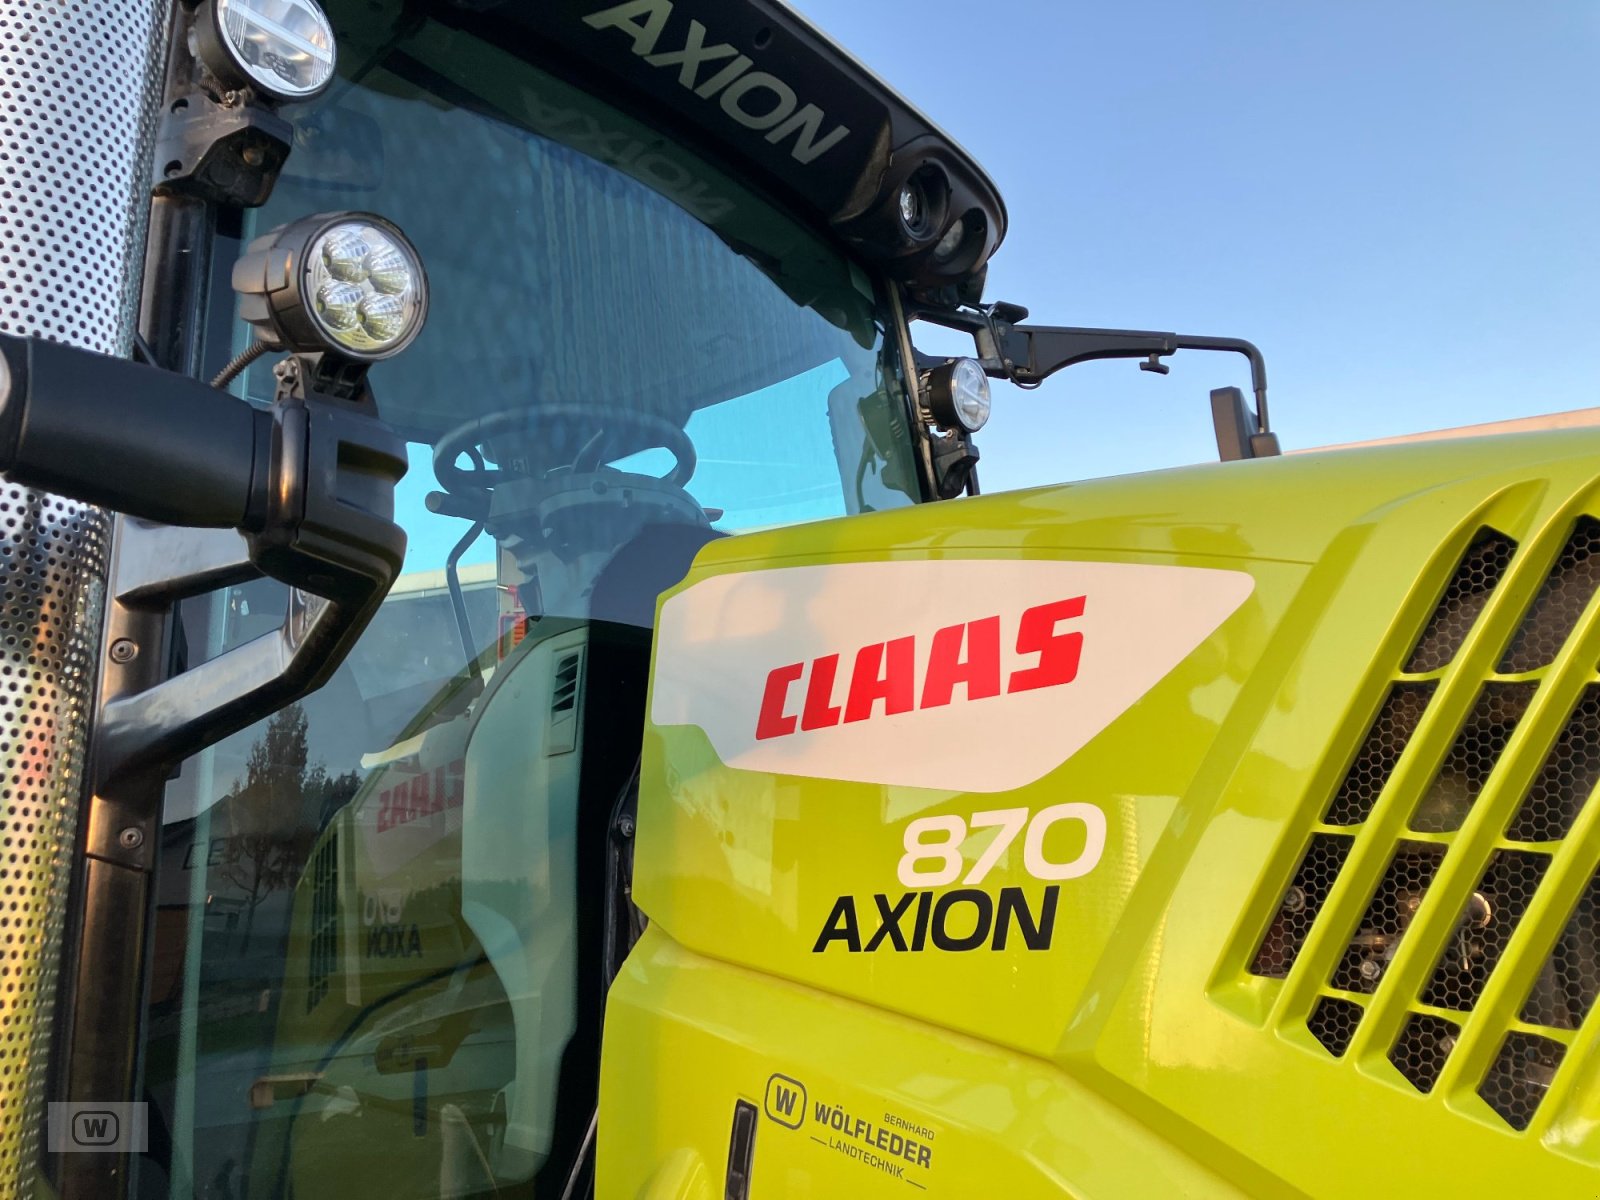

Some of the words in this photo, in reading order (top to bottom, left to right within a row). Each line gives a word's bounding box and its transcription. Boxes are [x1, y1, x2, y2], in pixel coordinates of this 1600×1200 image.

[581, 0, 850, 165] AXION
[755, 595, 1087, 741] CLAAS
[897, 802, 1107, 888] 870
[812, 885, 1060, 953] AXION
[775, 1084, 797, 1117] W
[883, 1112, 935, 1141] BERNHARD
[815, 1101, 932, 1169] WÖLFLEDER
[829, 1136, 905, 1179] LANDTECHNIK
